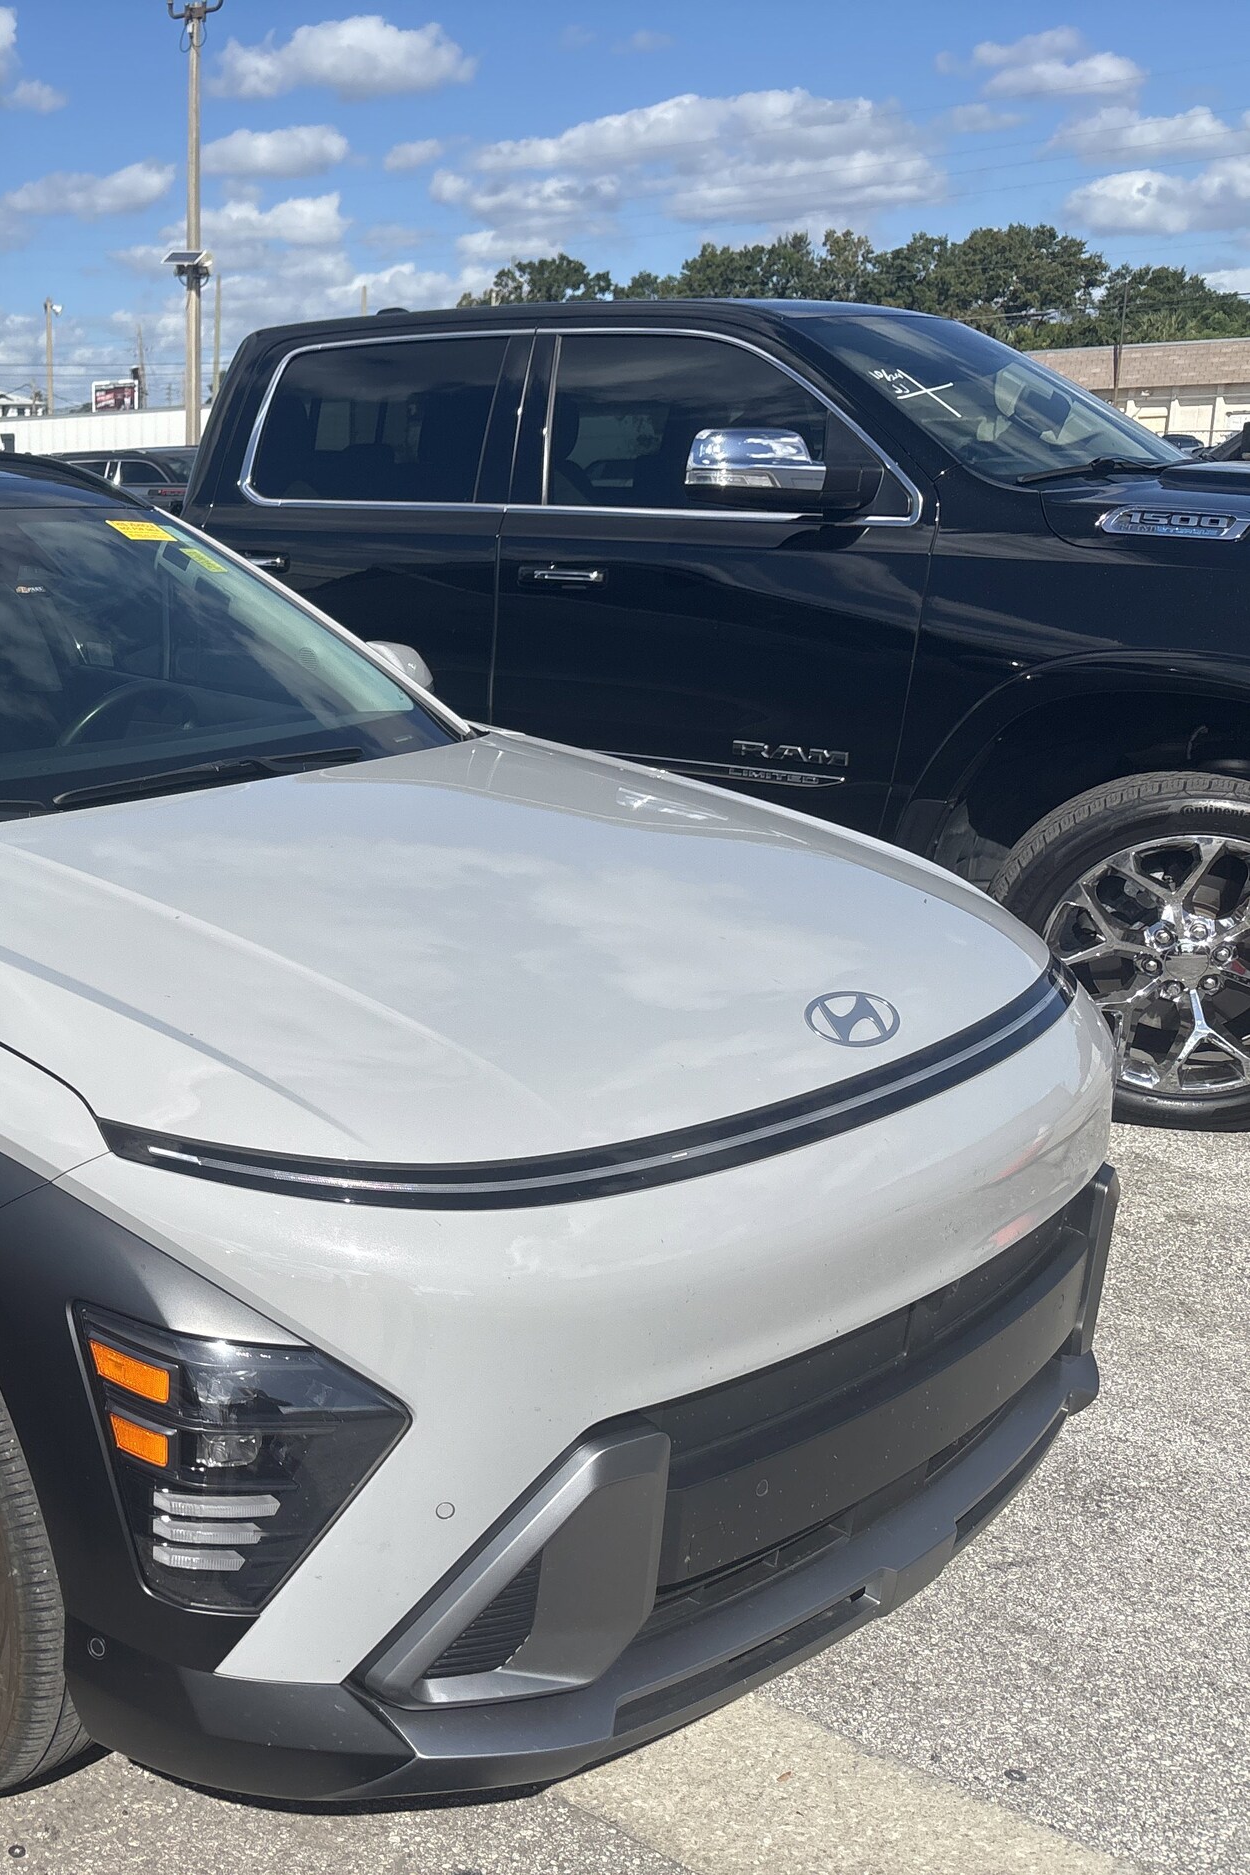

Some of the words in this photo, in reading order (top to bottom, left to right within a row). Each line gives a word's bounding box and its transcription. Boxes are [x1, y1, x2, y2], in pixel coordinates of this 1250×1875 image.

[1127, 511, 1228, 528] 1500
[732, 739, 849, 767] RAM
[728, 768, 819, 785] LIMITED
[1180, 804, 1250, 817] Continent
